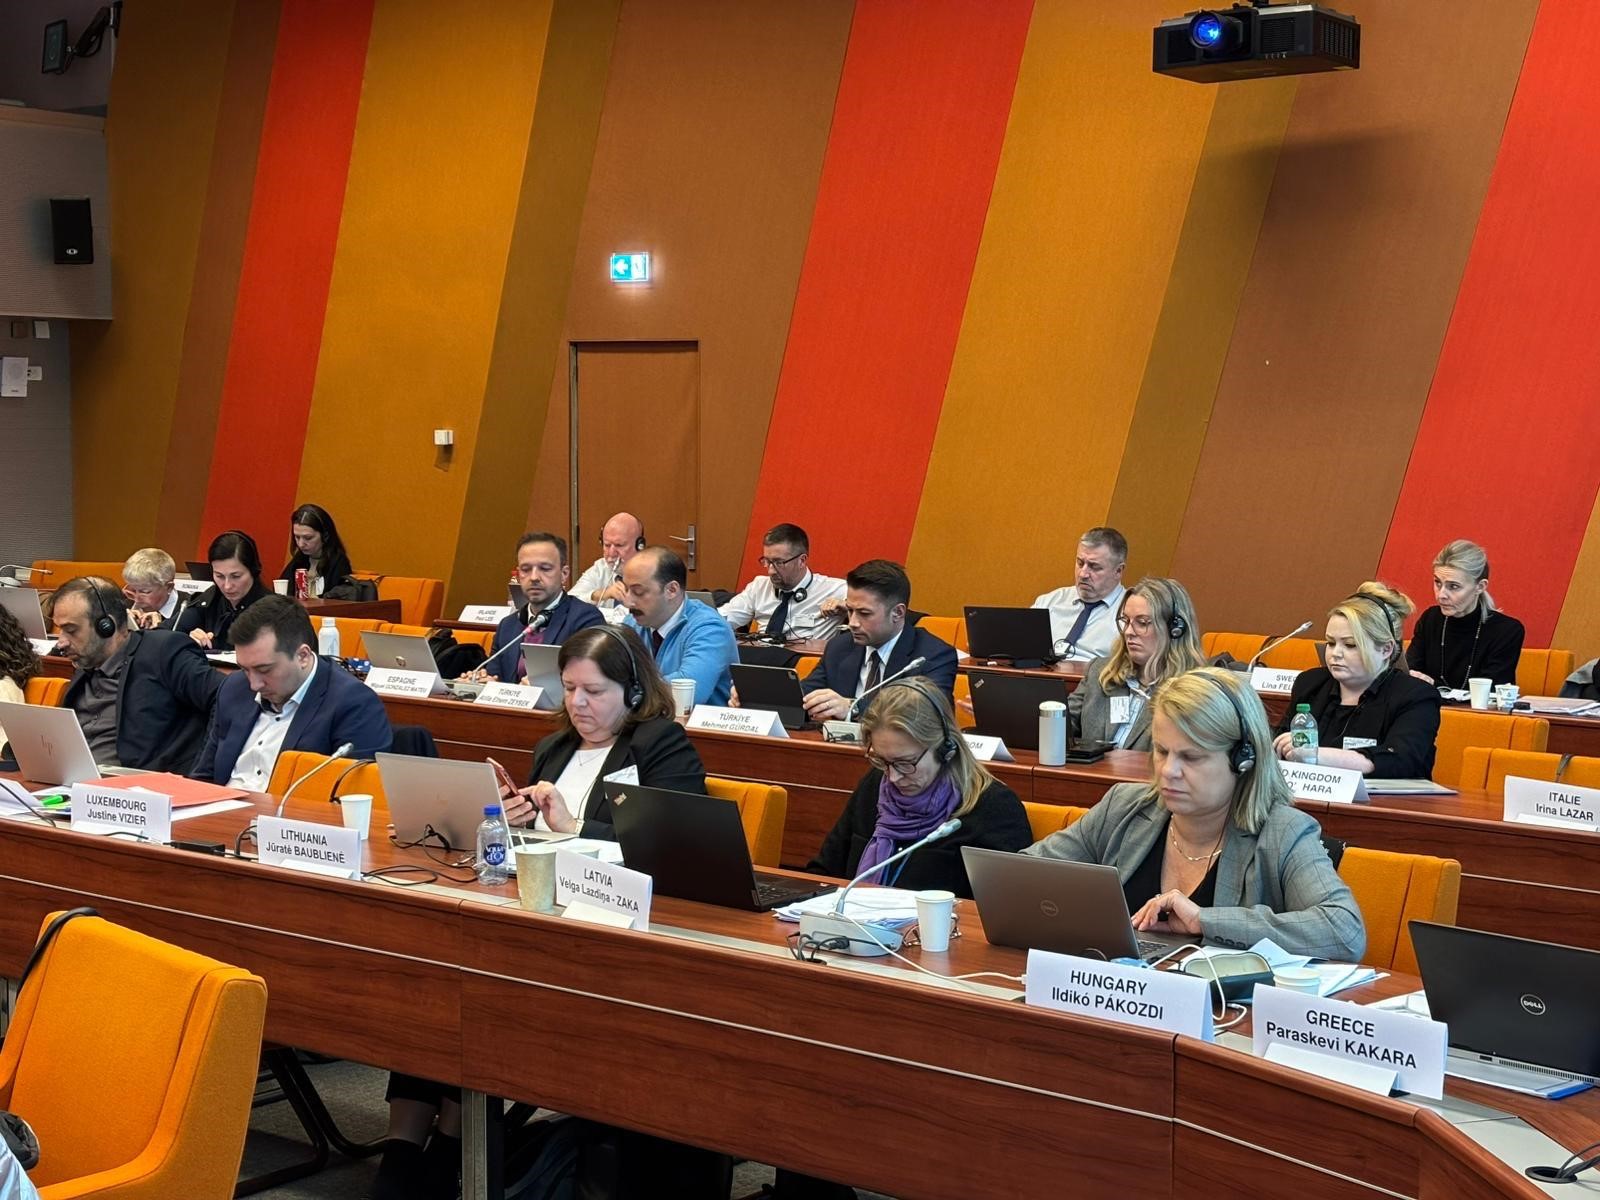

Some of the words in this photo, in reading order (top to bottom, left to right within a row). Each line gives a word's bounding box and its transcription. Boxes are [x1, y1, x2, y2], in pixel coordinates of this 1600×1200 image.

[387, 675, 417, 685] ESPAGNE
[1278, 683, 1292, 691] FEL
[701, 721, 729, 730] Mehmet
[729, 722, 760, 733] GÜRDAL
[1291, 770, 1342, 784] KINGDOM
[1303, 783, 1332, 794] HARA
[86, 794, 147, 812] LUXEMBOURG
[1549, 791, 1581, 806] ITALIE
[87, 809, 117, 822] Justine
[119, 812, 146, 826] VIZIER
[1536, 803, 1557, 815] Irina
[1560, 807, 1594, 821] LAZAR
[280, 828, 328, 846] LITHUANIA
[584, 868, 613, 887] LATVIA
[559, 875, 580, 893] Velga
[616, 895, 639, 913] ZAKA
[1070, 970, 1147, 996] HUNGARY
[1052, 986, 1090, 1007] Ildikó
[1094, 993, 1164, 1020] PÁKOZDI
[1306, 1009, 1375, 1038] GREECE
[1266, 1021, 1340, 1051] Paraskevi
[1344, 1039, 1417, 1069] KAKARA
